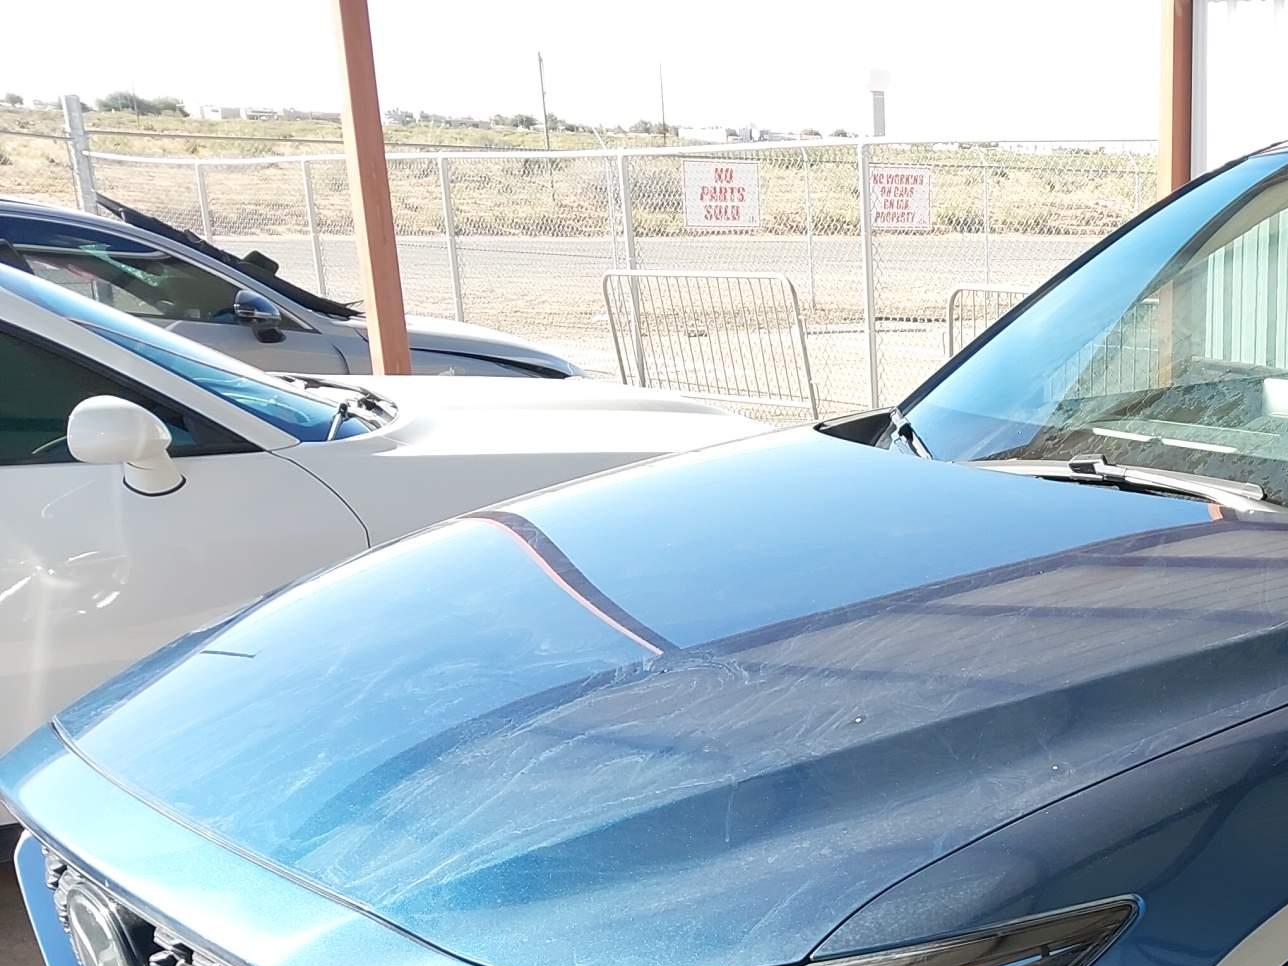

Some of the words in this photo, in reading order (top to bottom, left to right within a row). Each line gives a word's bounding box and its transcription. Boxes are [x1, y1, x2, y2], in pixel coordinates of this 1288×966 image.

[714, 167, 734, 184] NO
[699, 185, 746, 203] PARTS
[703, 204, 741, 221] SOLD
